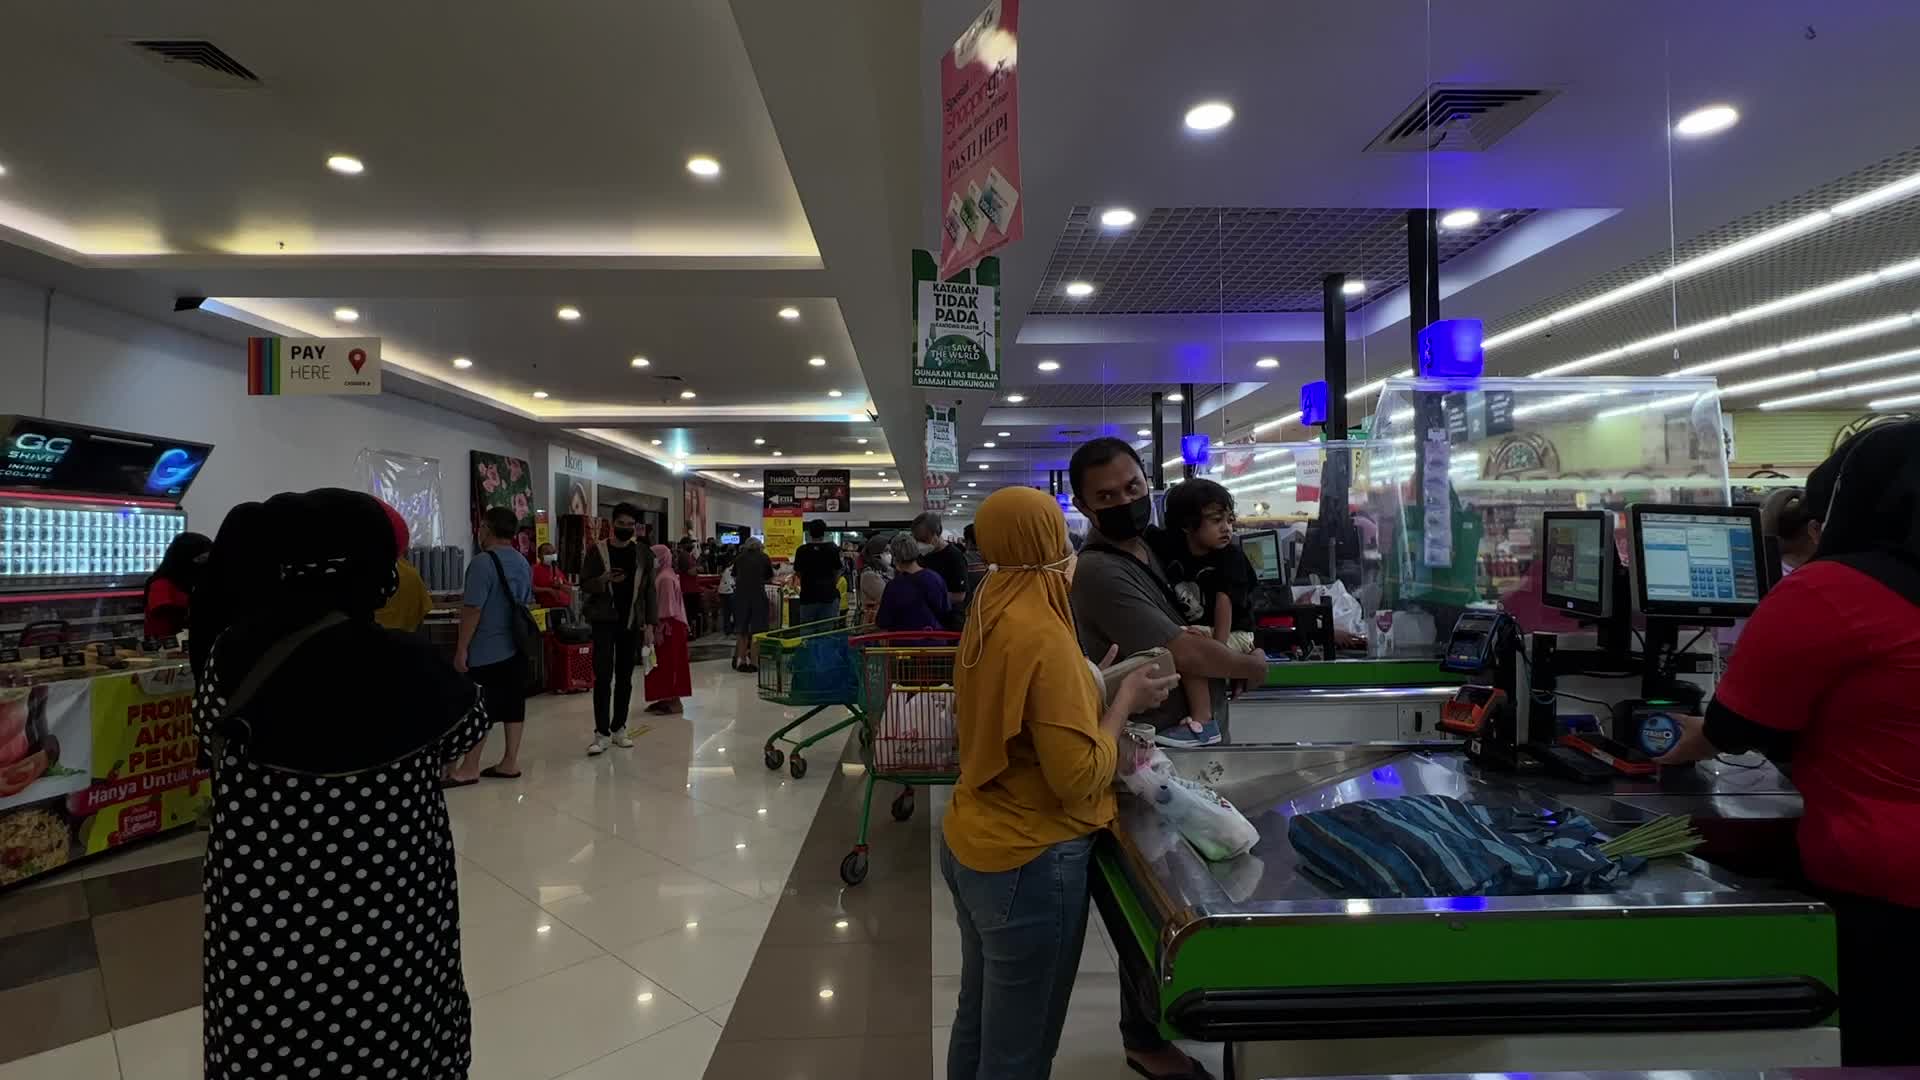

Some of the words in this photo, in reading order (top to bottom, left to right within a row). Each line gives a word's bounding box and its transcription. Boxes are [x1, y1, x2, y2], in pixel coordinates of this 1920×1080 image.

[948, 139, 976, 178] PASTI
[979, 112, 1008, 154] HEPI
[933, 283, 979, 295] KATAKAN
[934, 294, 978, 309] TIDAK
[935, 308, 979, 324] PADA
[291, 346, 326, 360] PAY
[931, 350, 948, 358] THE
[951, 343, 973, 352] SAVE
[290, 365, 332, 380] HERE
[953, 371, 966, 379] TAS
[967, 371, 998, 381] BELANJA
[918, 377, 946, 385] RAMAH
[947, 379, 995, 388] LINGKUNGAN
[15, 432, 73, 454] GG
[8, 463, 54, 473] INFINITE
[770, 476, 796, 484] THANKS
[796, 476, 809, 484] FOR
[810, 476, 846, 484] SHOPPING
[88, 781, 137, 807] Hanya
